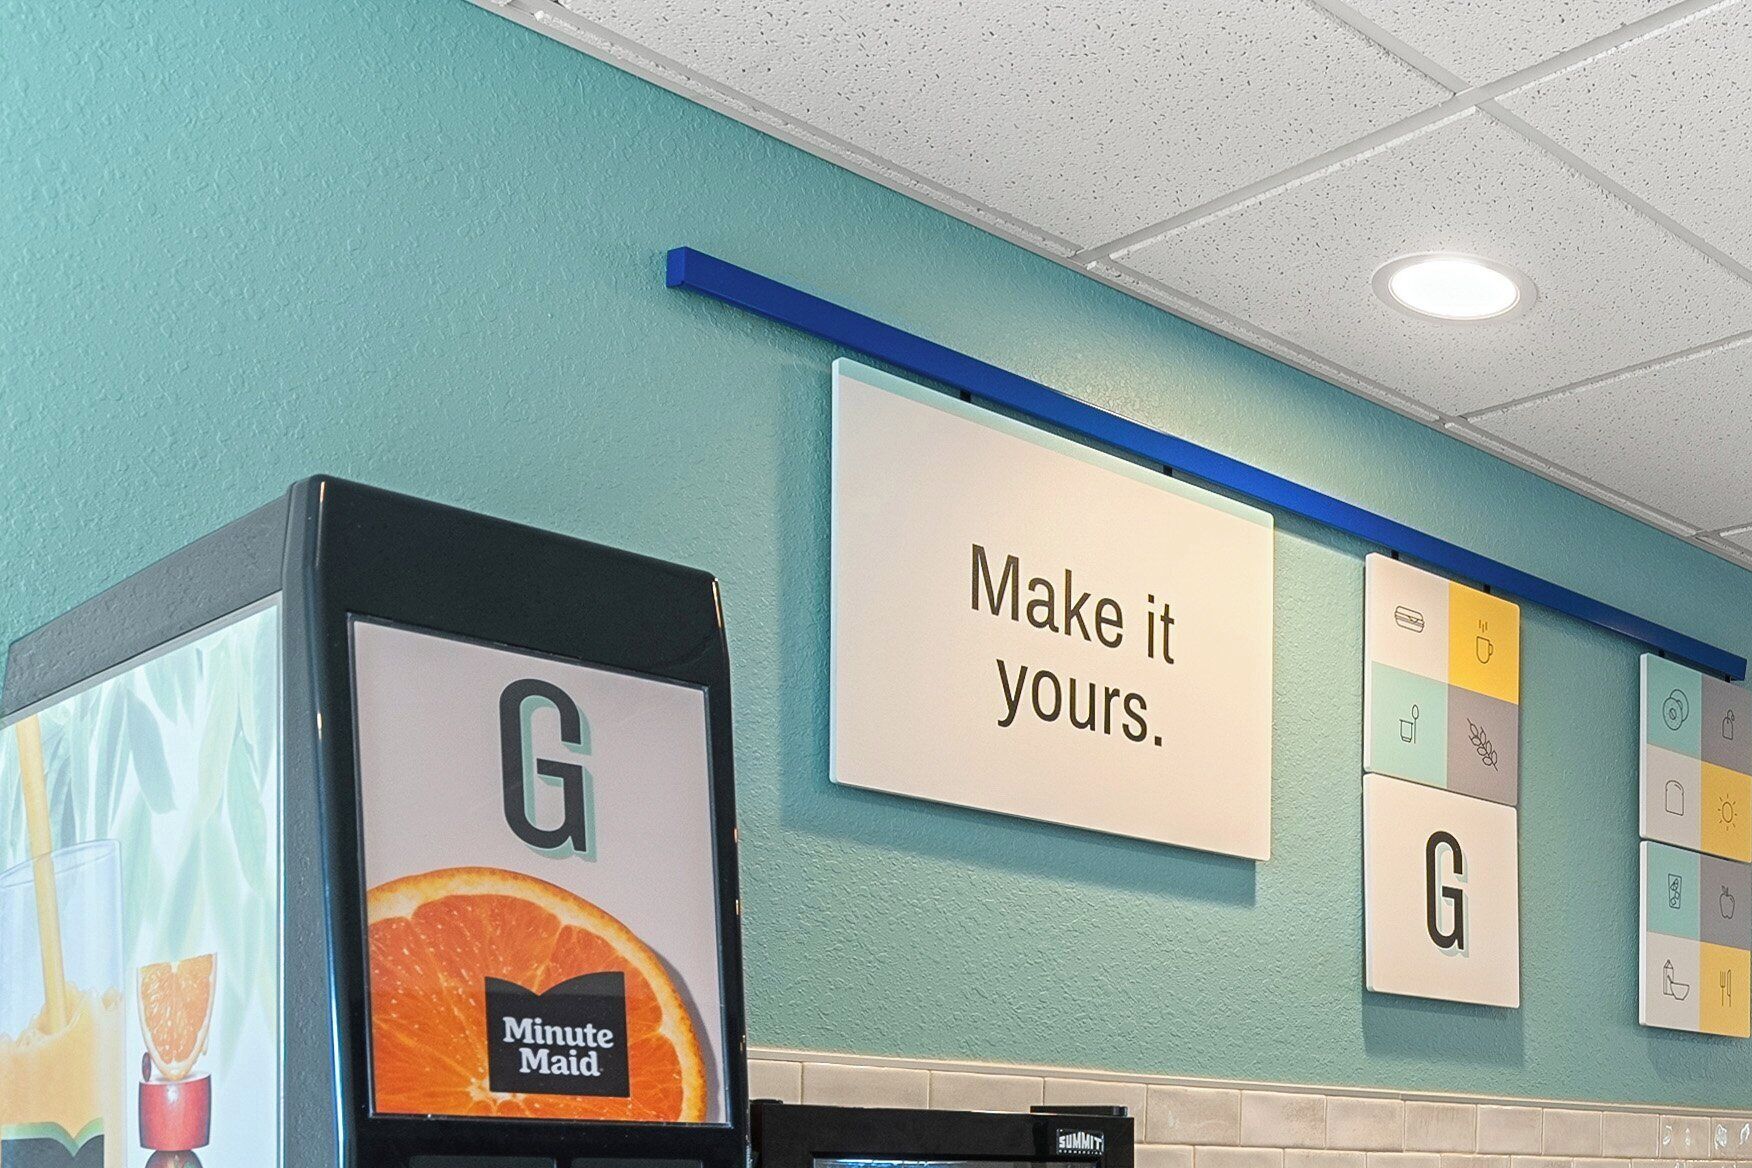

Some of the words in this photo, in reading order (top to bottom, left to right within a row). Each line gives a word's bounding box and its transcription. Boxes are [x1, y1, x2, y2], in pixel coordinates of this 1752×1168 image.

[972, 543, 1124, 649] Make
[1147, 594, 1175, 665] it
[996, 658, 1163, 747] yours.
[499, 678, 590, 855] G
[1425, 830, 1465, 951] G
[502, 1016, 614, 1049] Minute
[518, 1047, 601, 1077] Maid
[1058, 1131, 1102, 1150] SUMMIT
